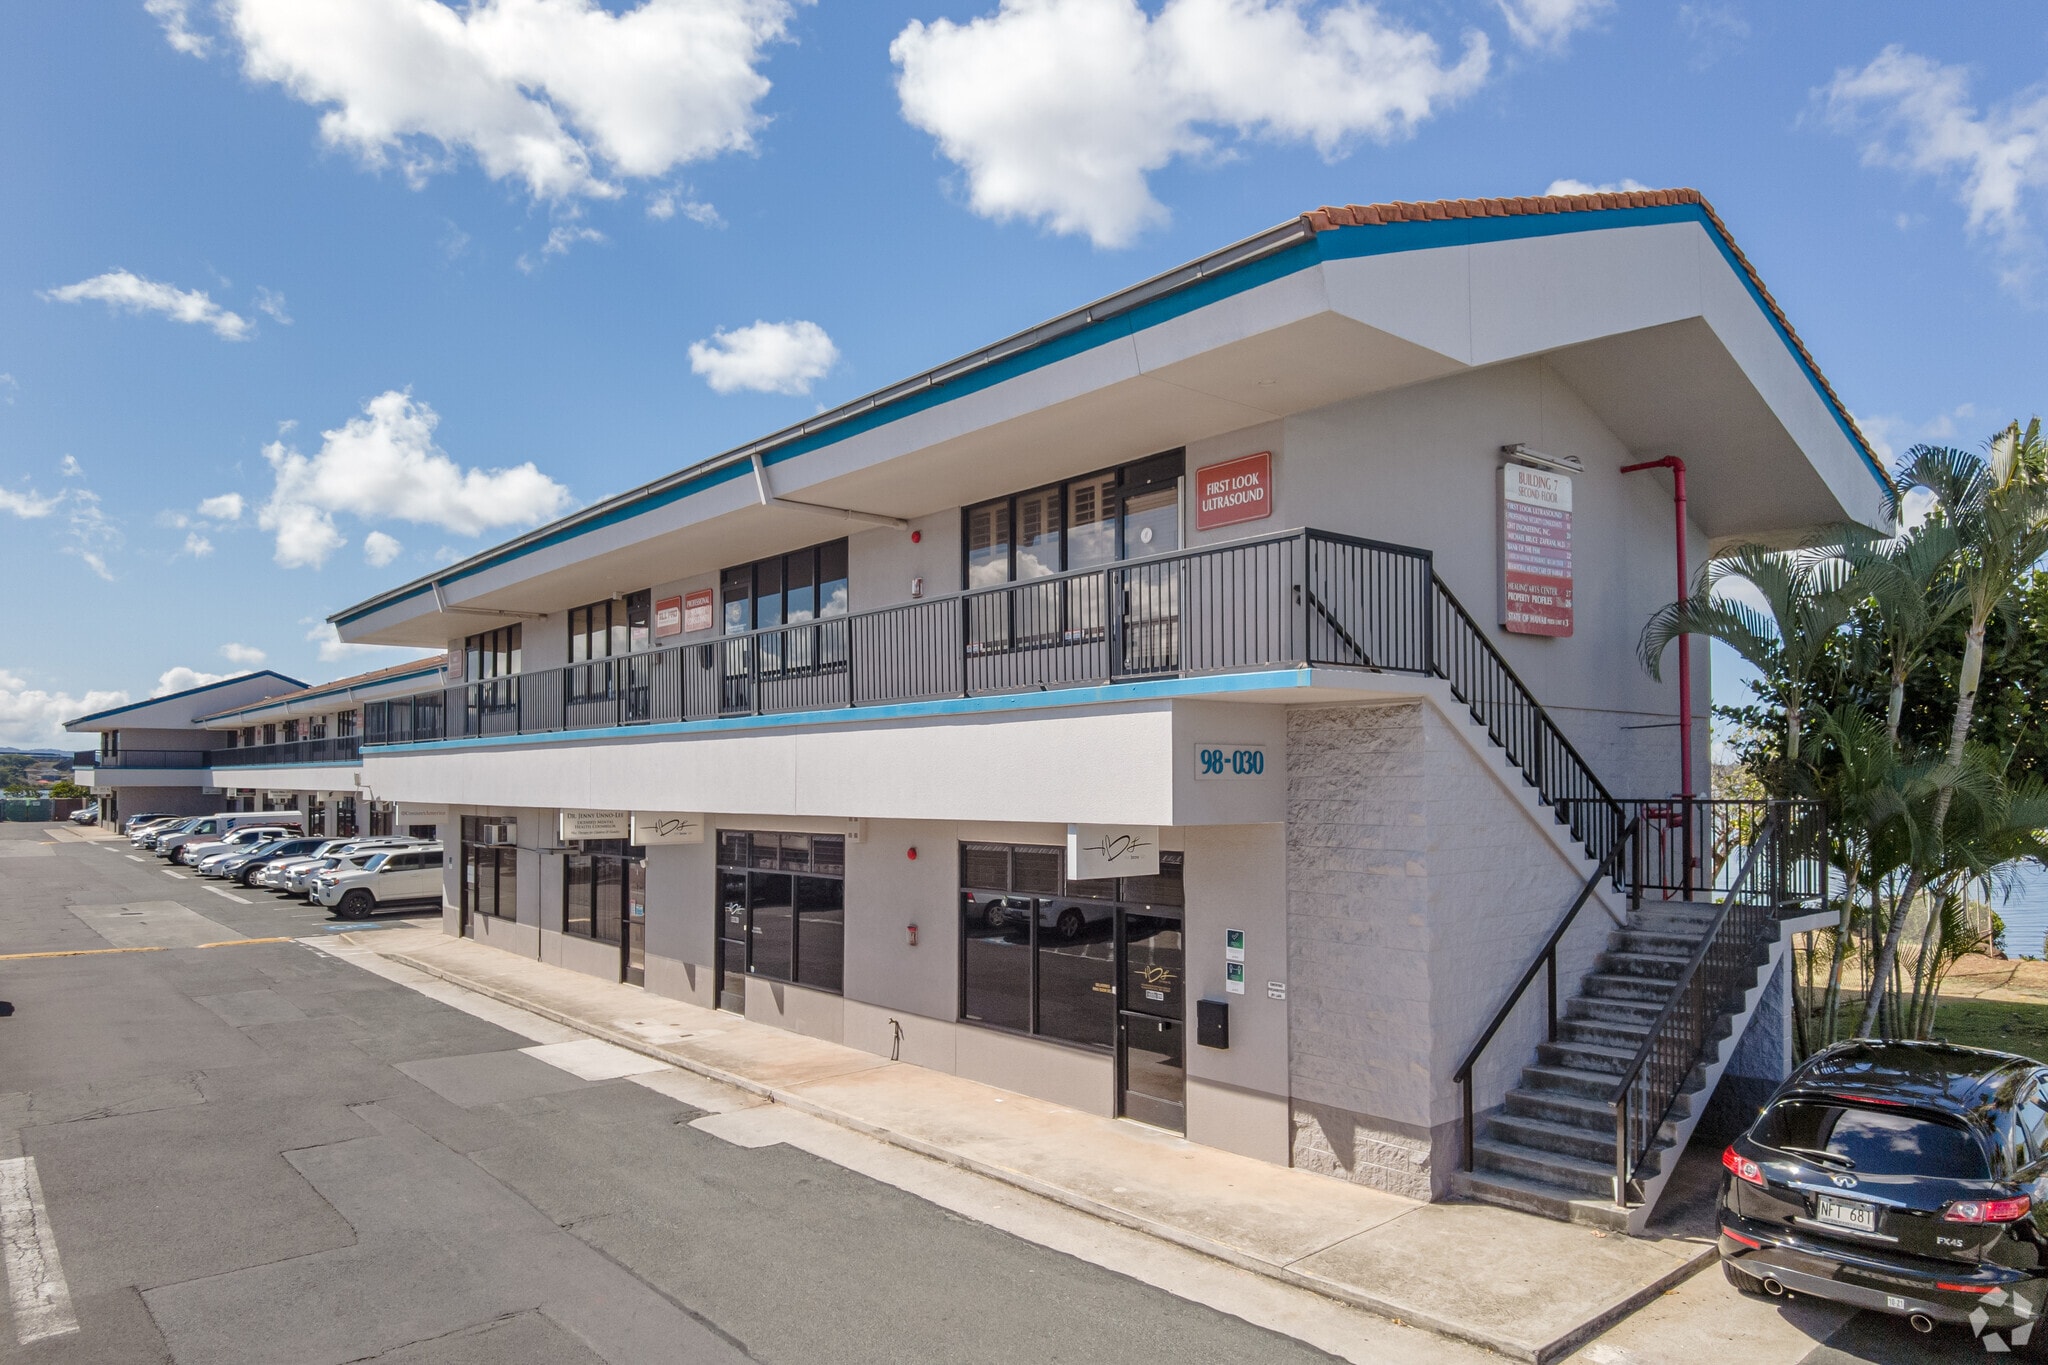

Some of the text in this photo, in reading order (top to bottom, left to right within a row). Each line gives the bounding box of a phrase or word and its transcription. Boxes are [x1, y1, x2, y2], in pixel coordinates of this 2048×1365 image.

[1207, 473, 1259, 496] FIRST LOOK
[1519, 472, 1558, 491] BUILDING 7
[1202, 487, 1264, 512] ULTRASOUND
[1518, 486, 1558, 503] SECOND FLOOR
[1508, 582, 1528, 592] HEALING
[1529, 585, 1540, 594] ARTS
[1541, 586, 1558, 596] CENTER
[1508, 592, 1530, 603] PROPERTY
[1532, 595, 1553, 606] PROFILES
[1508, 611, 1521, 622] STATE
[1522, 614, 1530, 623] OF
[1201, 749, 1264, 775] 98-030
[1821, 1202, 1842, 1219] NFT
[1849, 1207, 1870, 1225] 681
[1936, 1236, 1964, 1248] FX45
